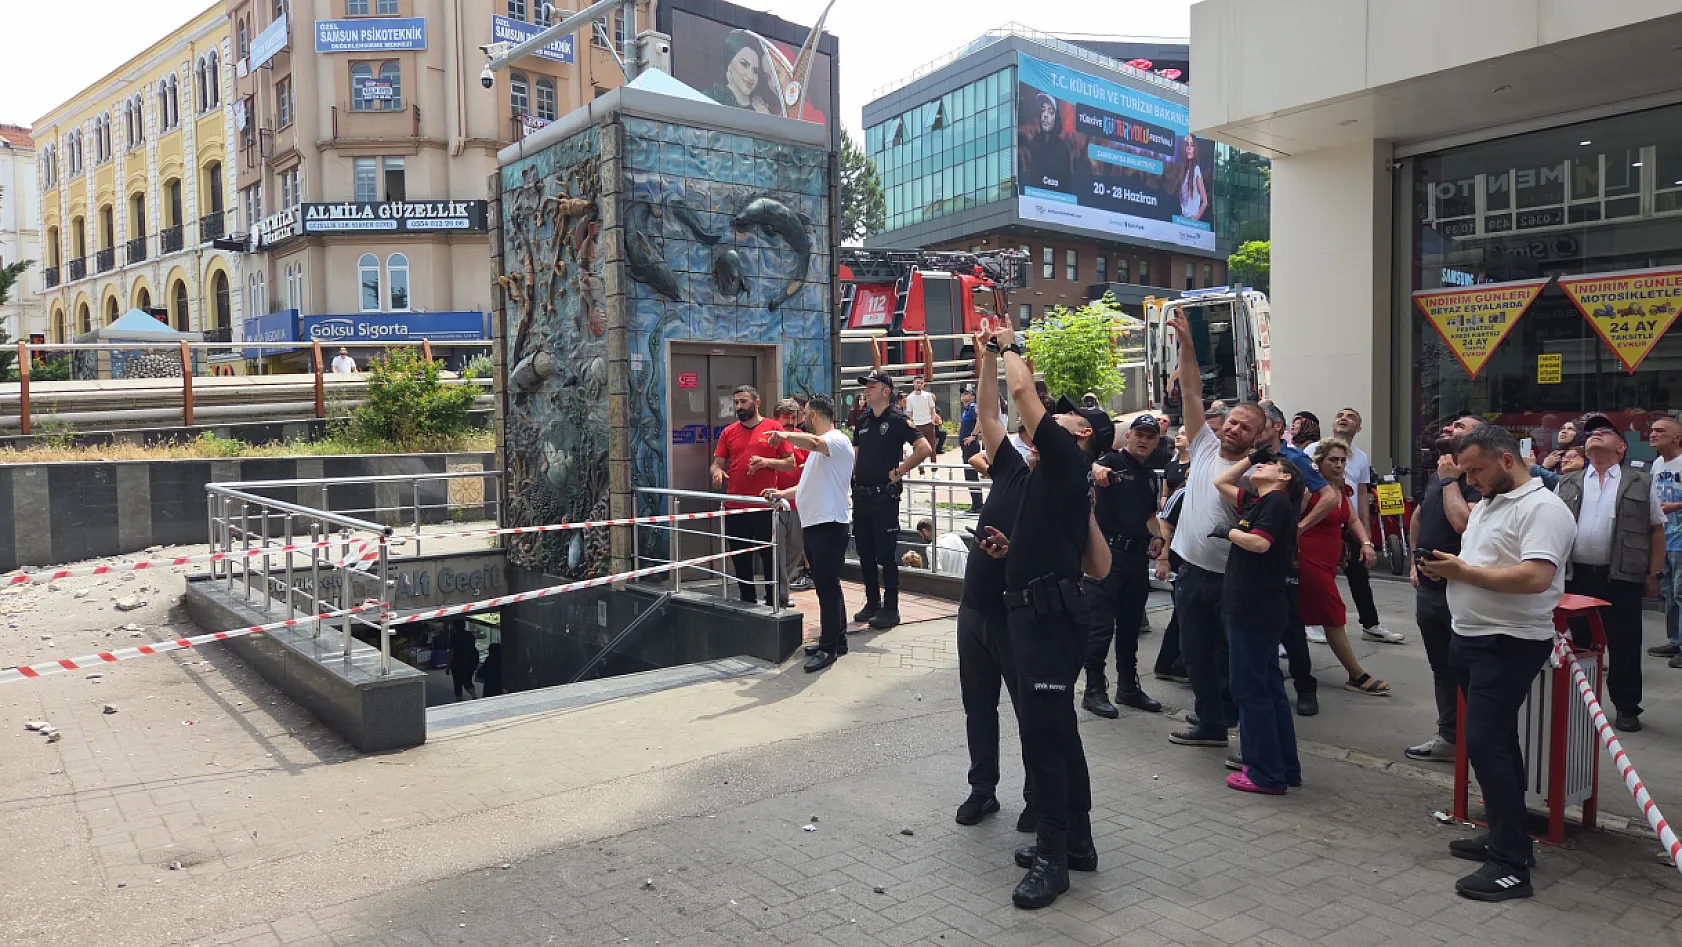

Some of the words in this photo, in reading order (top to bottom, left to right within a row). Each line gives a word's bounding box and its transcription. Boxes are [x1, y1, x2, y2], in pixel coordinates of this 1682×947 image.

[320, 22, 339, 30] ÖZEL
[320, 29, 359, 43] SAMSUN
[361, 25, 422, 41] PSİKOTEKNİK
[495, 25, 526, 41] SAMSUN
[1051, 73, 1069, 90] T.C.
[1069, 78, 1106, 102] KÜLTÜR
[1107, 90, 1119, 105] VE
[1120, 94, 1153, 115] TURİZM
[1093, 181, 1105, 196] 20
[1112, 185, 1123, 199] 28
[1124, 187, 1158, 207] Haziran
[306, 202, 375, 219] ALMİLA
[379, 200, 469, 219] GÜZELLİK
[1574, 280, 1629, 294] İNDİRİM
[868, 295, 887, 312] 112
[1425, 294, 1472, 308] İNDİRİM
[1475, 289, 1531, 303] GÜNLERİ
[1580, 288, 1682, 304] MOTOSİKLETLE
[1430, 305, 1462, 316] BEYAZ
[1464, 300, 1524, 313] EŞYALARDA
[310, 323, 354, 338] Göksu
[358, 323, 409, 339] Sigorta
[1609, 321, 1630, 333] 24
[1635, 320, 1658, 332] AY
[1461, 338, 1473, 346] 24
[1475, 337, 1488, 346] AY
[1611, 332, 1654, 341] TAKSİTLE
[1617, 341, 1647, 349] EVKUR
[397, 570, 430, 596] Alt
[437, 562, 500, 596] Geçit
